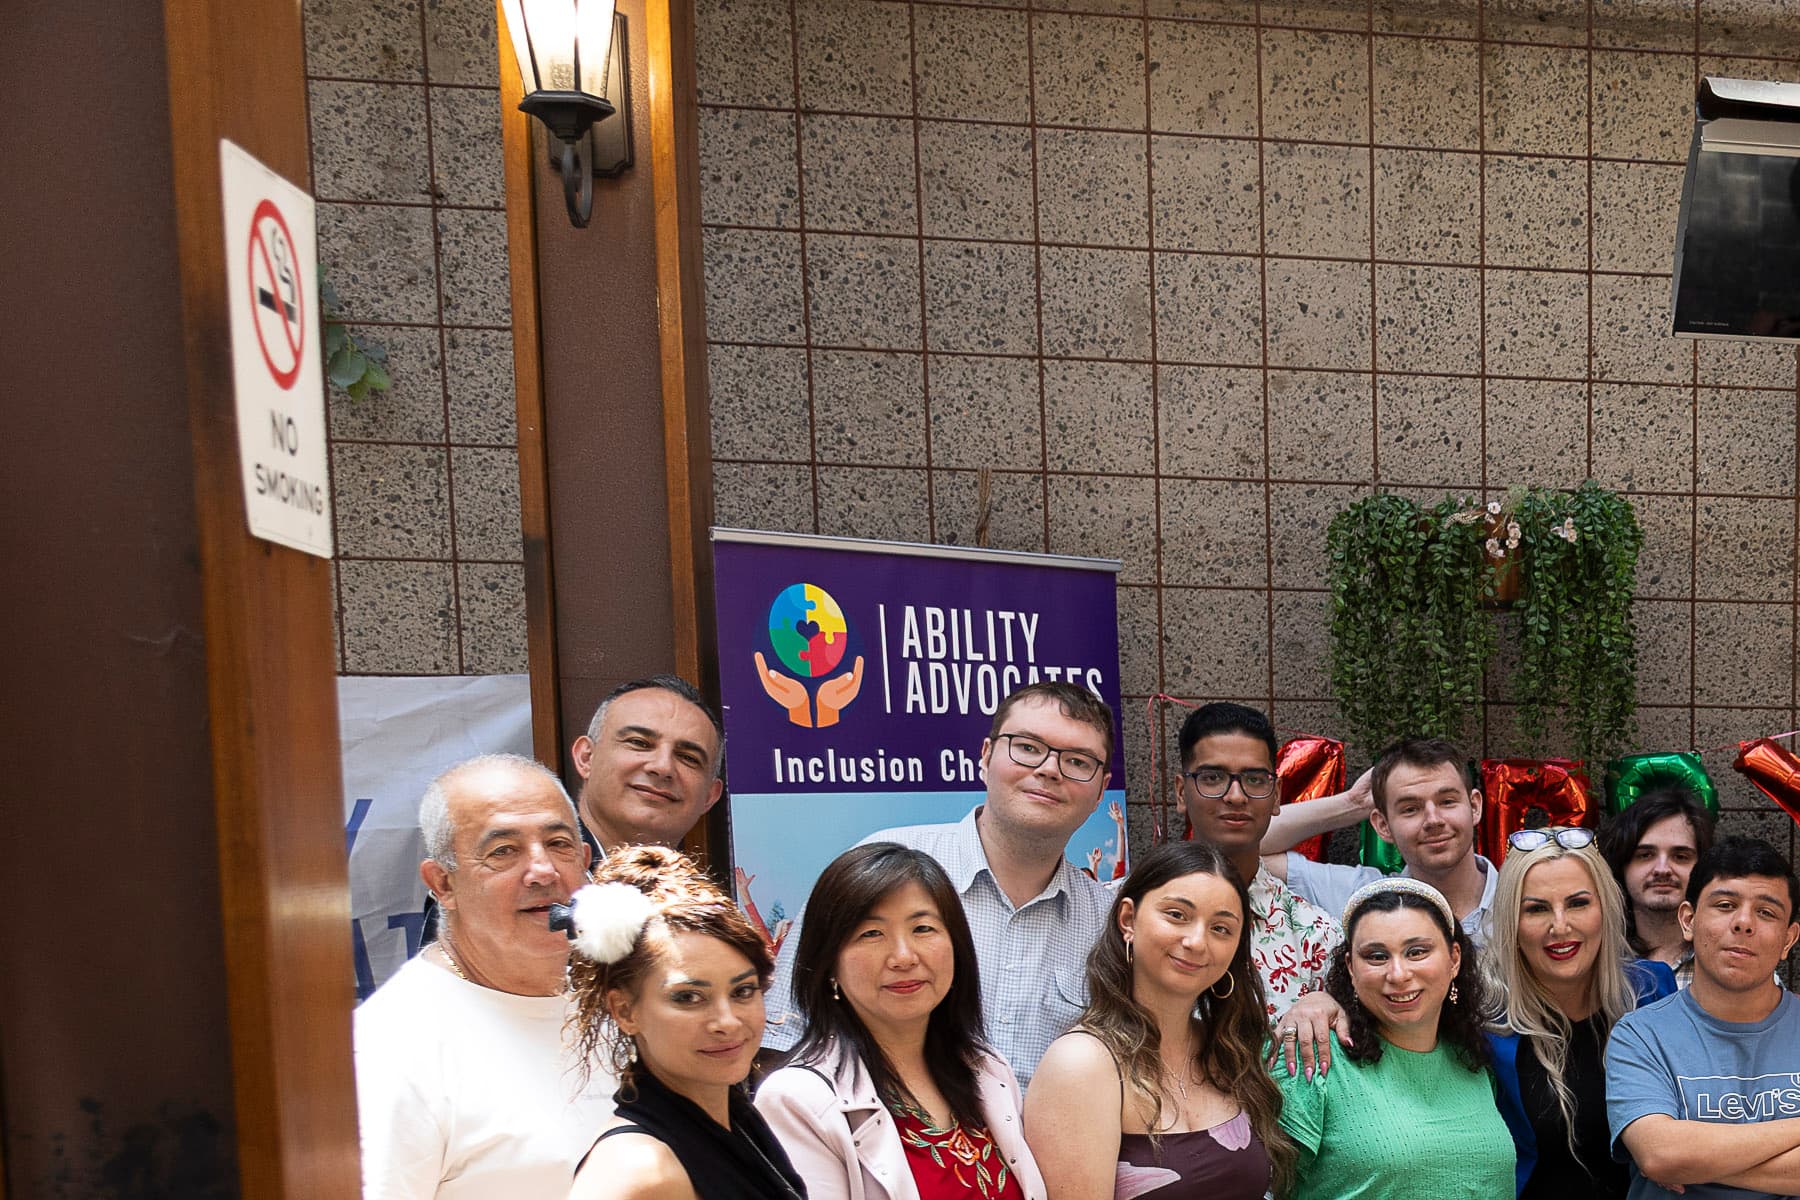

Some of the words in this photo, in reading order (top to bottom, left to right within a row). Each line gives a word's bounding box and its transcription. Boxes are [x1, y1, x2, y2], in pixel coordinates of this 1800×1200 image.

[270, 410, 298, 456] NO
[256, 463, 323, 516] SMOKING
[902, 605, 1039, 663] ABILITY
[774, 748, 924, 783] Inclusion
[940, 748, 985, 782] Ch
